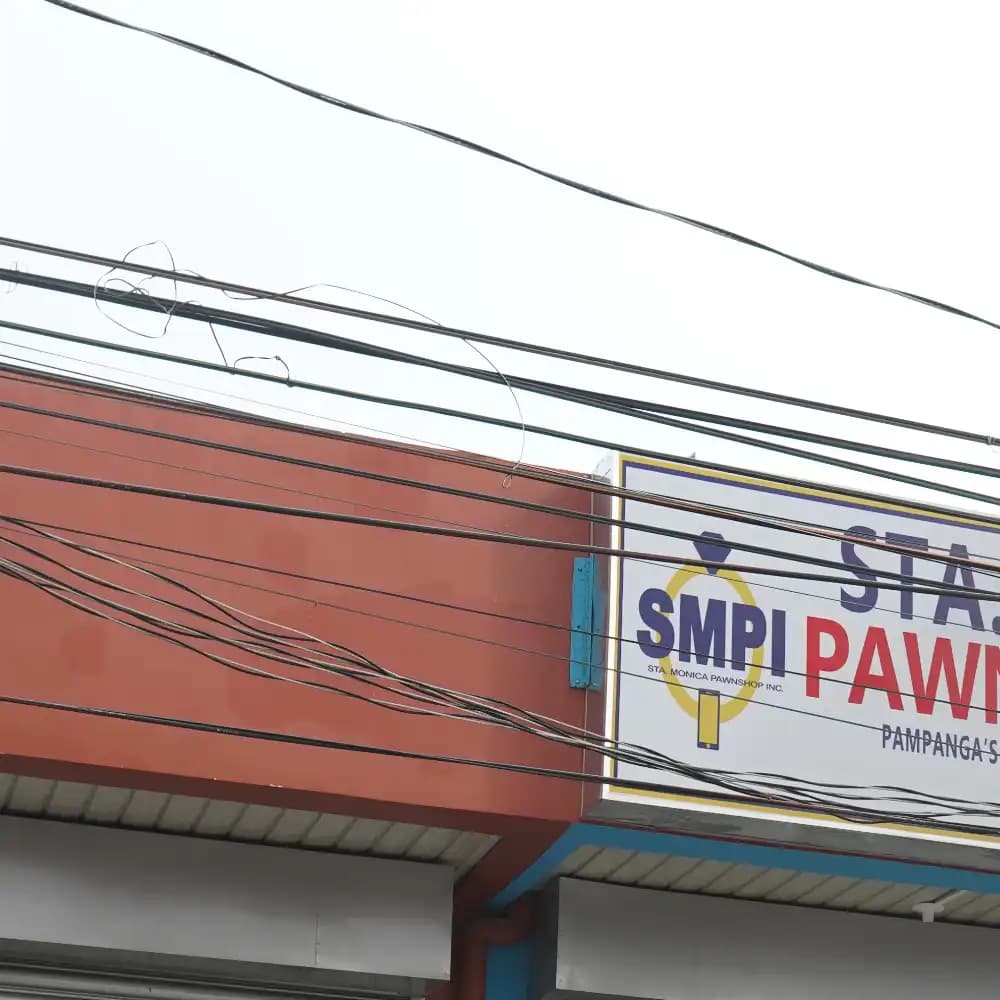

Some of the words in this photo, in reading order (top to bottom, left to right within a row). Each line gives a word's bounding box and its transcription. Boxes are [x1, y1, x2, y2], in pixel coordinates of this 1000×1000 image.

[636, 587, 786, 677] SMPI
[670, 668, 708, 681] MONICA
[710, 674, 764, 689] PAWNSHOP
[766, 683, 784, 692] INC.
[881, 724, 998, 764] PAMPANGA'S
